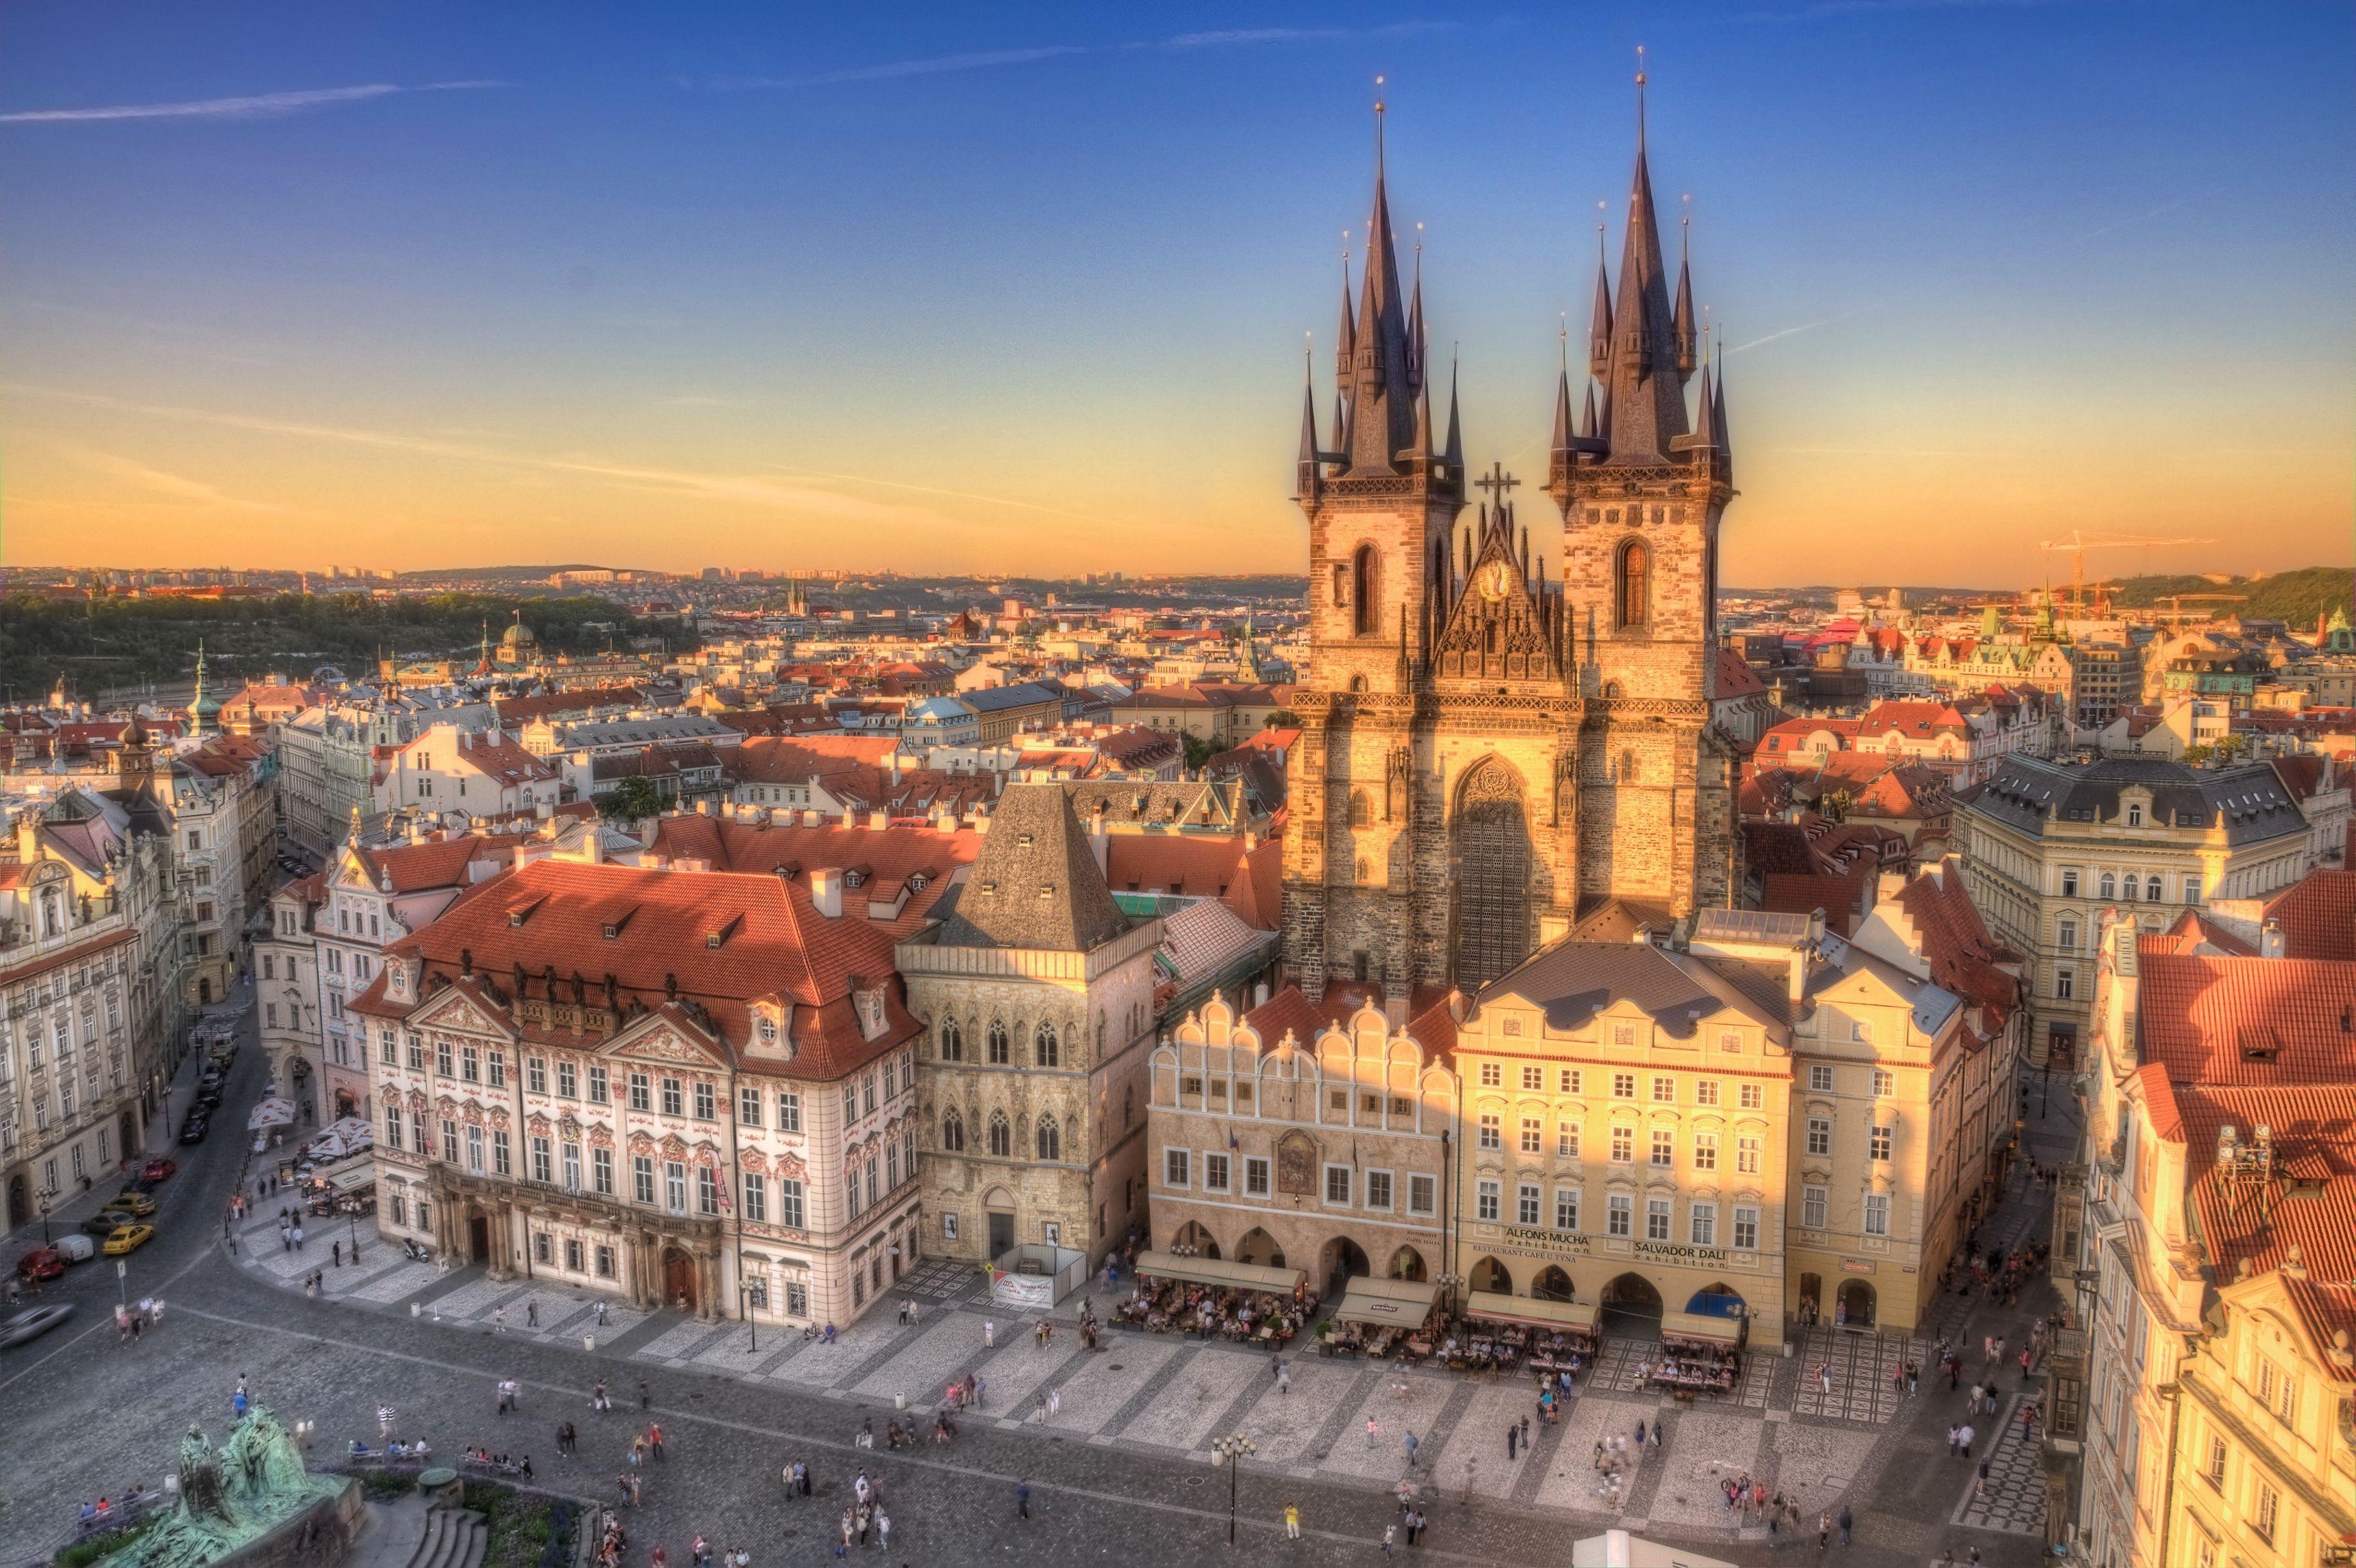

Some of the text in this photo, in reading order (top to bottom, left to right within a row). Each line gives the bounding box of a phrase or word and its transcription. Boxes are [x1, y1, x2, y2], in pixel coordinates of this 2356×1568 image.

[1506, 1228, 1588, 1245] ALFONS MUCHA
[1473, 1244, 1523, 1256] RESTAURANT
[1525, 1250, 1545, 1258] CAFÉ
[1508, 1239, 1589, 1254] exhibition
[1635, 1242, 1695, 1257] SALVADOR
[1635, 1254, 1725, 1269] exhibition
